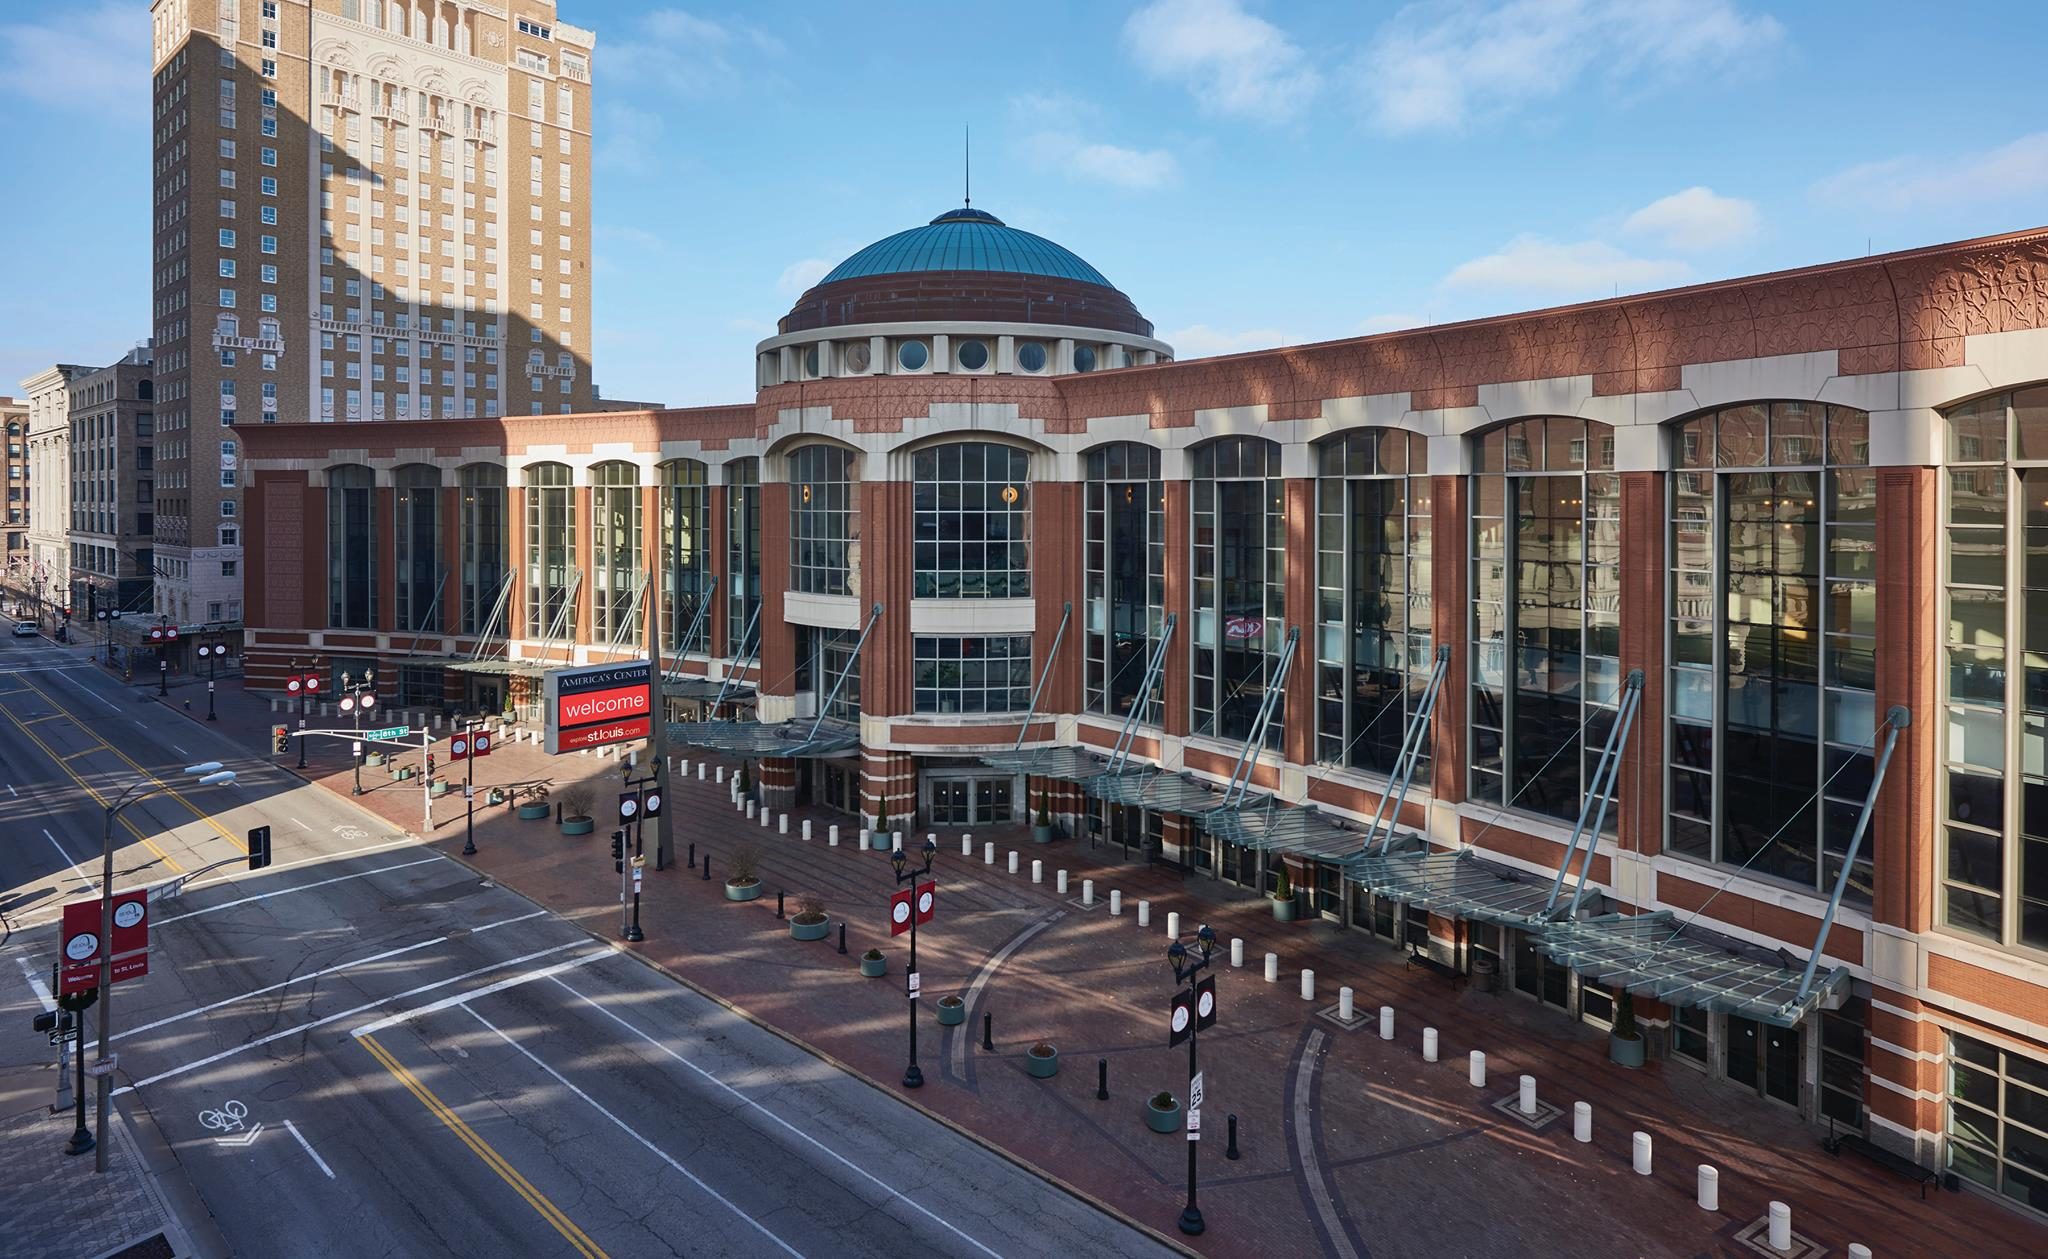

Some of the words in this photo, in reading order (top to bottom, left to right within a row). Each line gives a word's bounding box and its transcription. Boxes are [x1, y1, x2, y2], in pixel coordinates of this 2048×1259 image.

[561, 673, 611, 687] AMERICA'S
[613, 668, 648, 681] CENTER
[566, 695, 644, 718] welcome
[1191, 1088, 1201, 1106] 25
